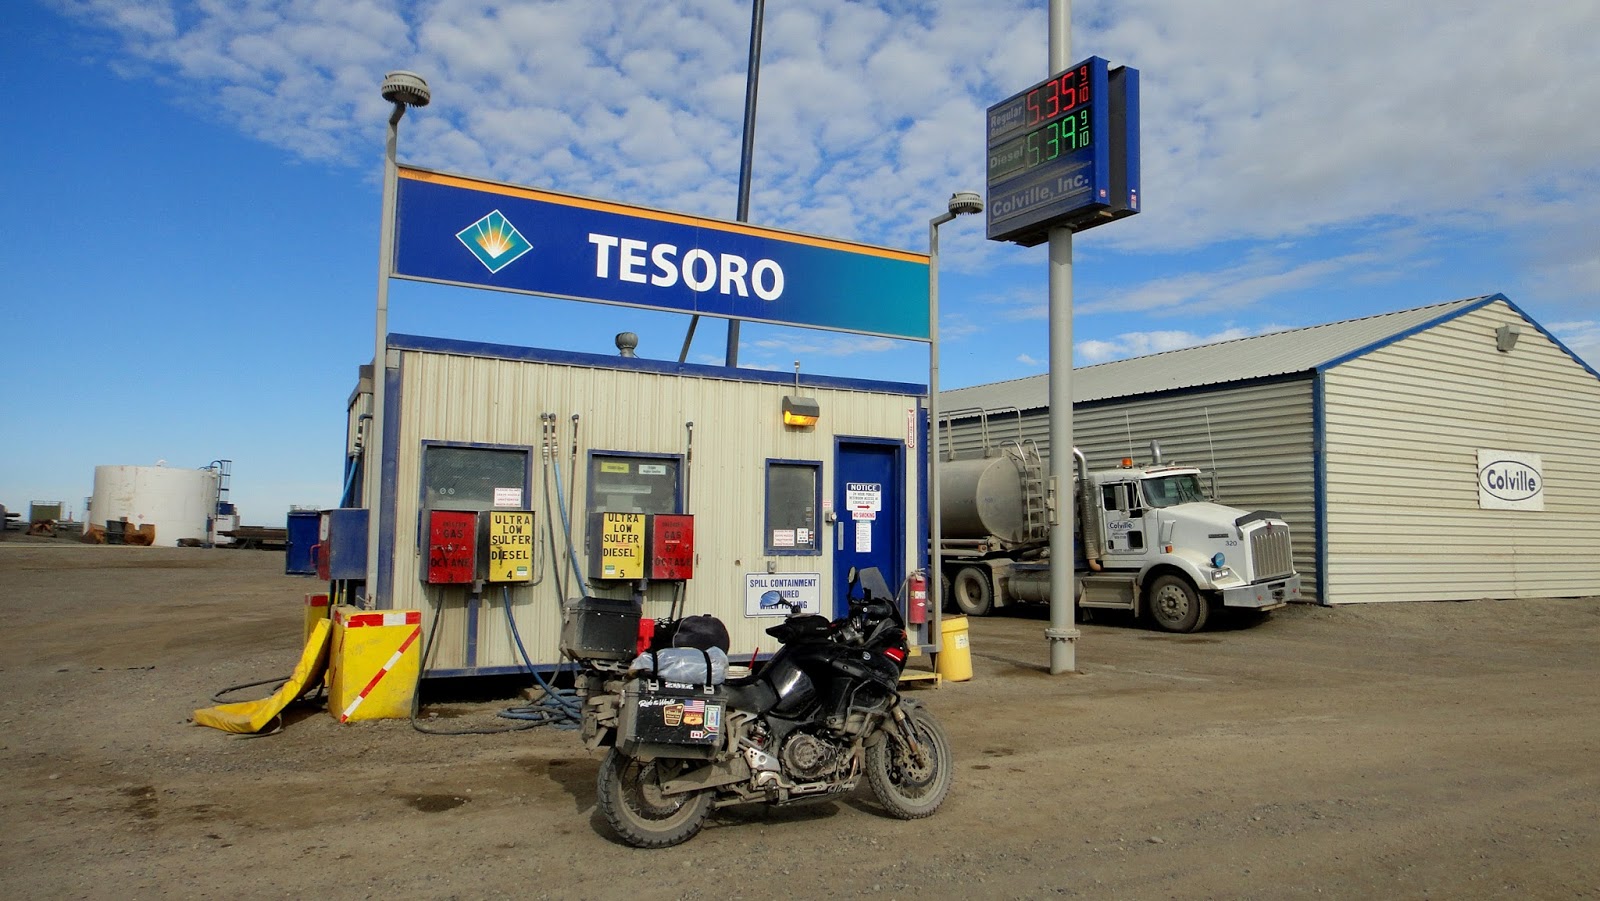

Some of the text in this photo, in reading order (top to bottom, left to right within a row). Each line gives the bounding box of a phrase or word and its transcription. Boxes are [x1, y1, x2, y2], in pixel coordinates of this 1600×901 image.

[1027, 71, 1075, 127] 5.35
[990, 105, 1023, 128] Regular
[1027, 115, 1075, 168] 5.39
[990, 145, 1024, 169] Diesel
[992, 174, 1089, 217] Colville, Inc.
[588, 232, 785, 301] TESORO
[1487, 469, 1536, 492] Colville
[494, 515, 531, 525] ULTRA
[608, 513, 639, 523] ULTRA
[502, 525, 523, 535] LOW
[614, 523, 633, 533] LOW
[443, 529, 464, 539] GAS
[603, 533, 639, 543] SULFER
[664, 530, 682, 539] GAS
[491, 535, 531, 545] SULFER
[491, 550, 529, 560] DIESEL
[603, 547, 635, 557] DIESEL
[506, 570, 513, 580] 4
[619, 569, 625, 578] 5
[749, 579, 817, 588] SPILL CONTAINMENT
